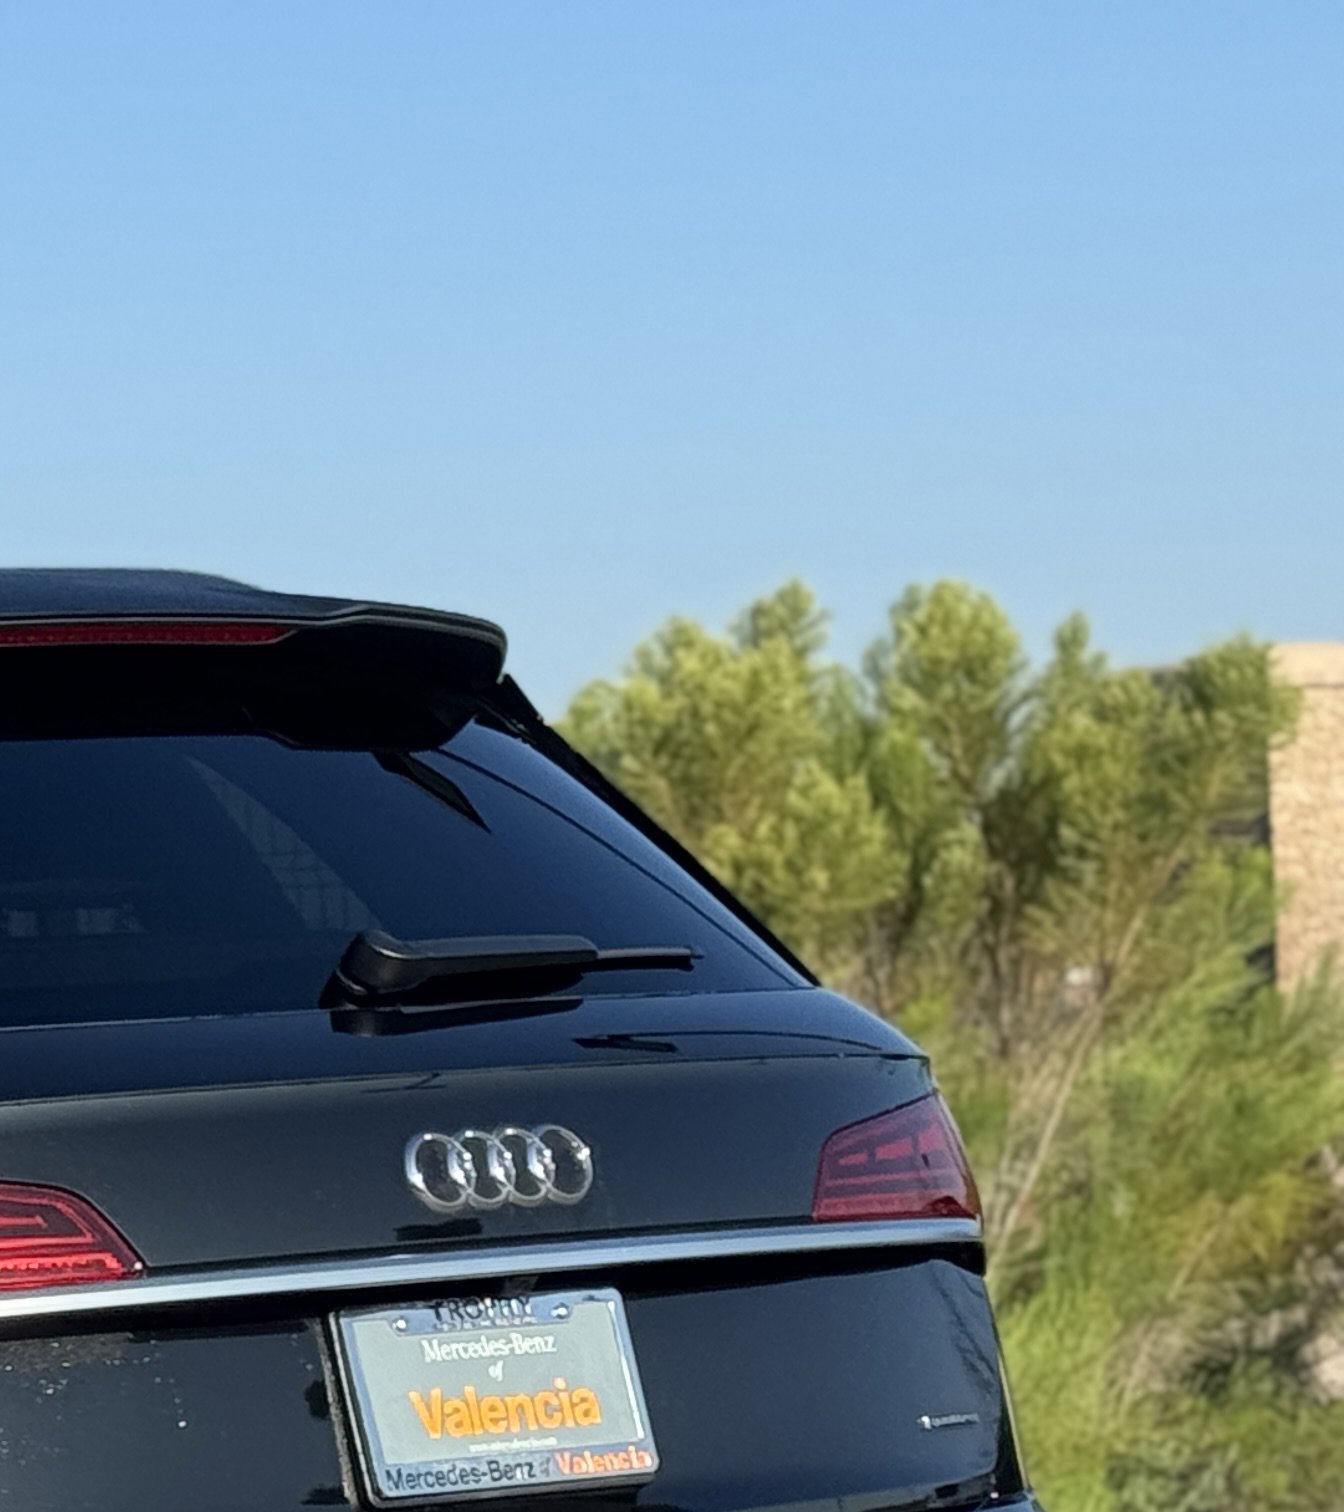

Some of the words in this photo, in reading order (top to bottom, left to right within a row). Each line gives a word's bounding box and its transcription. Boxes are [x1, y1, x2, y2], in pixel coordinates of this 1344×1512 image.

[420, 1332, 558, 1363] Mercedes-Benz
[487, 1360, 505, 1382] of
[409, 1376, 602, 1440] Valencia
[385, 1458, 537, 1492] Mercedes-Benz
[554, 1445, 653, 1475] Valencia
